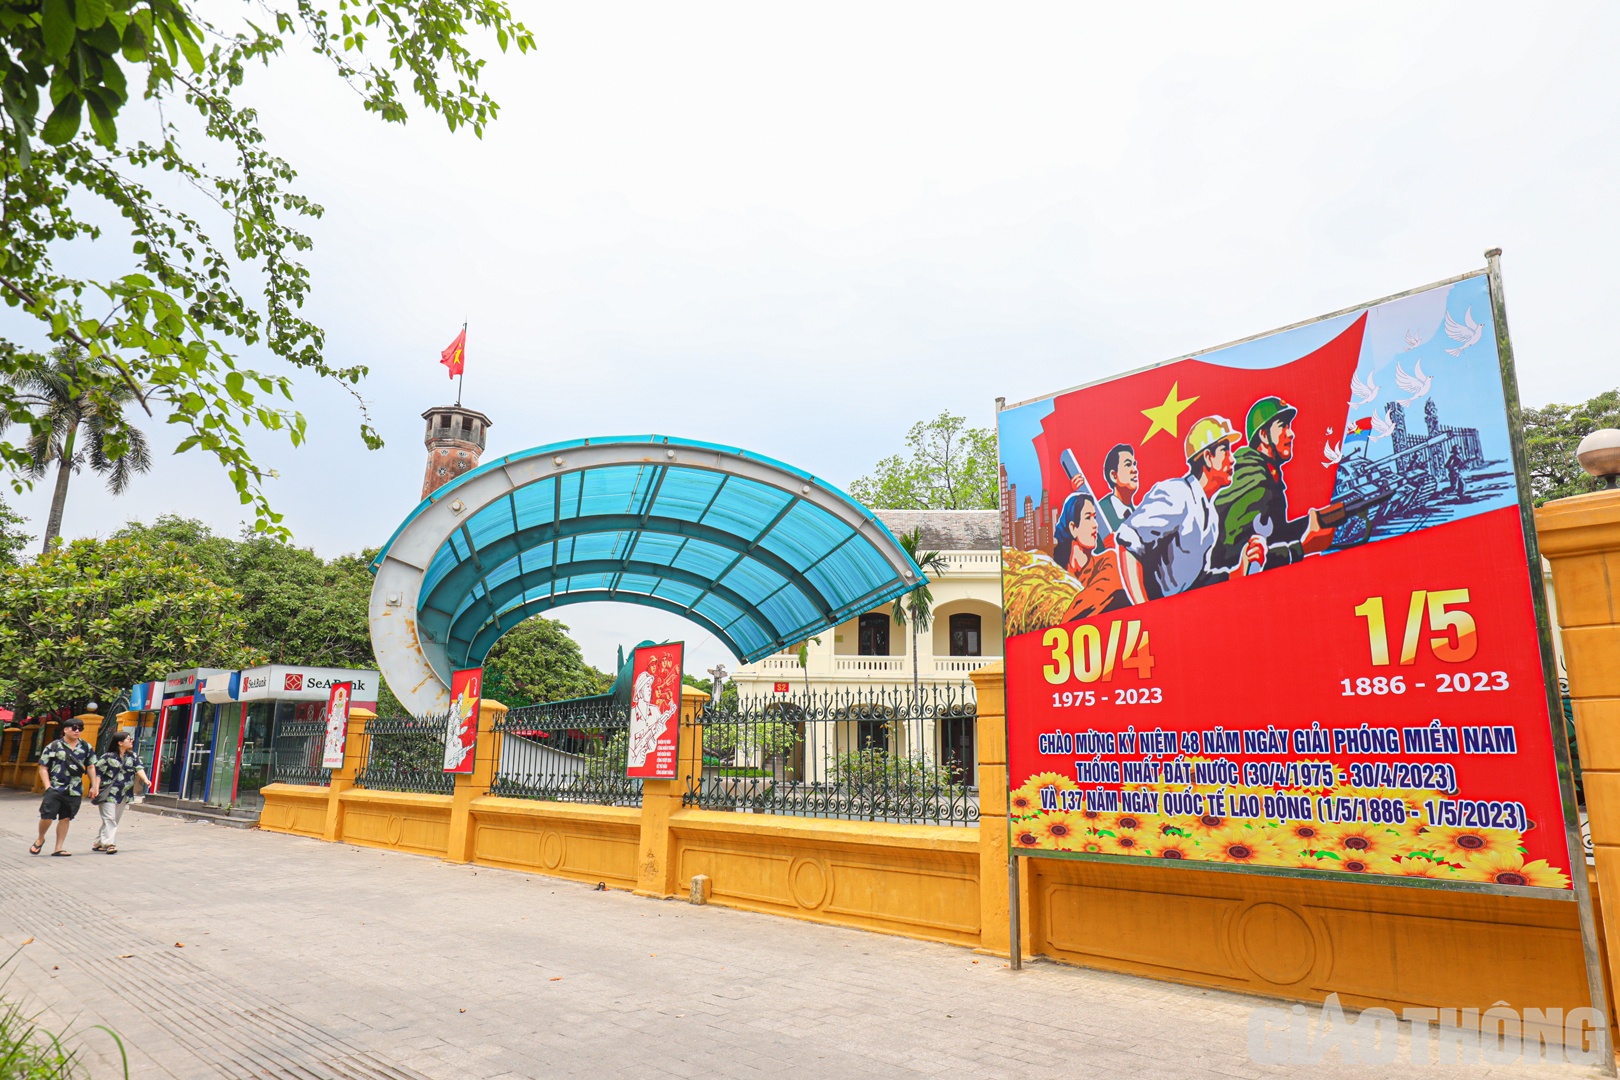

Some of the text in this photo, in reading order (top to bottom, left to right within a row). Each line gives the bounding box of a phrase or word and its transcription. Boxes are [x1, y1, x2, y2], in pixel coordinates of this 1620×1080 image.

[1354, 587, 1478, 666] 1/5
[1042, 619, 1155, 685] 30/4
[307, 678, 365, 690] SeAnk
[1052, 690, 1096, 708] 1975
[1114, 687, 1163, 705] 2023
[1340, 675, 1406, 696] 1886
[1435, 671, 1510, 693] 2023
[1039, 719, 1517, 758] CHÀO MỪNG KỶ NIỆM 48 NĂM NGÀY GIẢI PHÓNG MIỀN NAM
[1075, 756, 1120, 784] THỐNG
[1123, 755, 1161, 784] NHẤT
[1163, 755, 1192, 785] ĐẤT
[1194, 756, 1239, 786] NƯỚC
[1243, 762, 1334, 788] (30/4/1975
[1350, 763, 1457, 793] 30/4/2023)
[1040, 785, 1058, 810] VÀ
[1059, 790, 1083, 811] 137
[1086, 786, 1119, 812] NĂM
[1121, 787, 1160, 814] NGÀY
[1163, 786, 1204, 817] QUỐC
[1206, 786, 1226, 817] TẾ
[1229, 794, 1260, 818] LAO
[1263, 791, 1312, 824] ĐỘNG
[1424, 800, 1528, 832] 1/5/2023)
